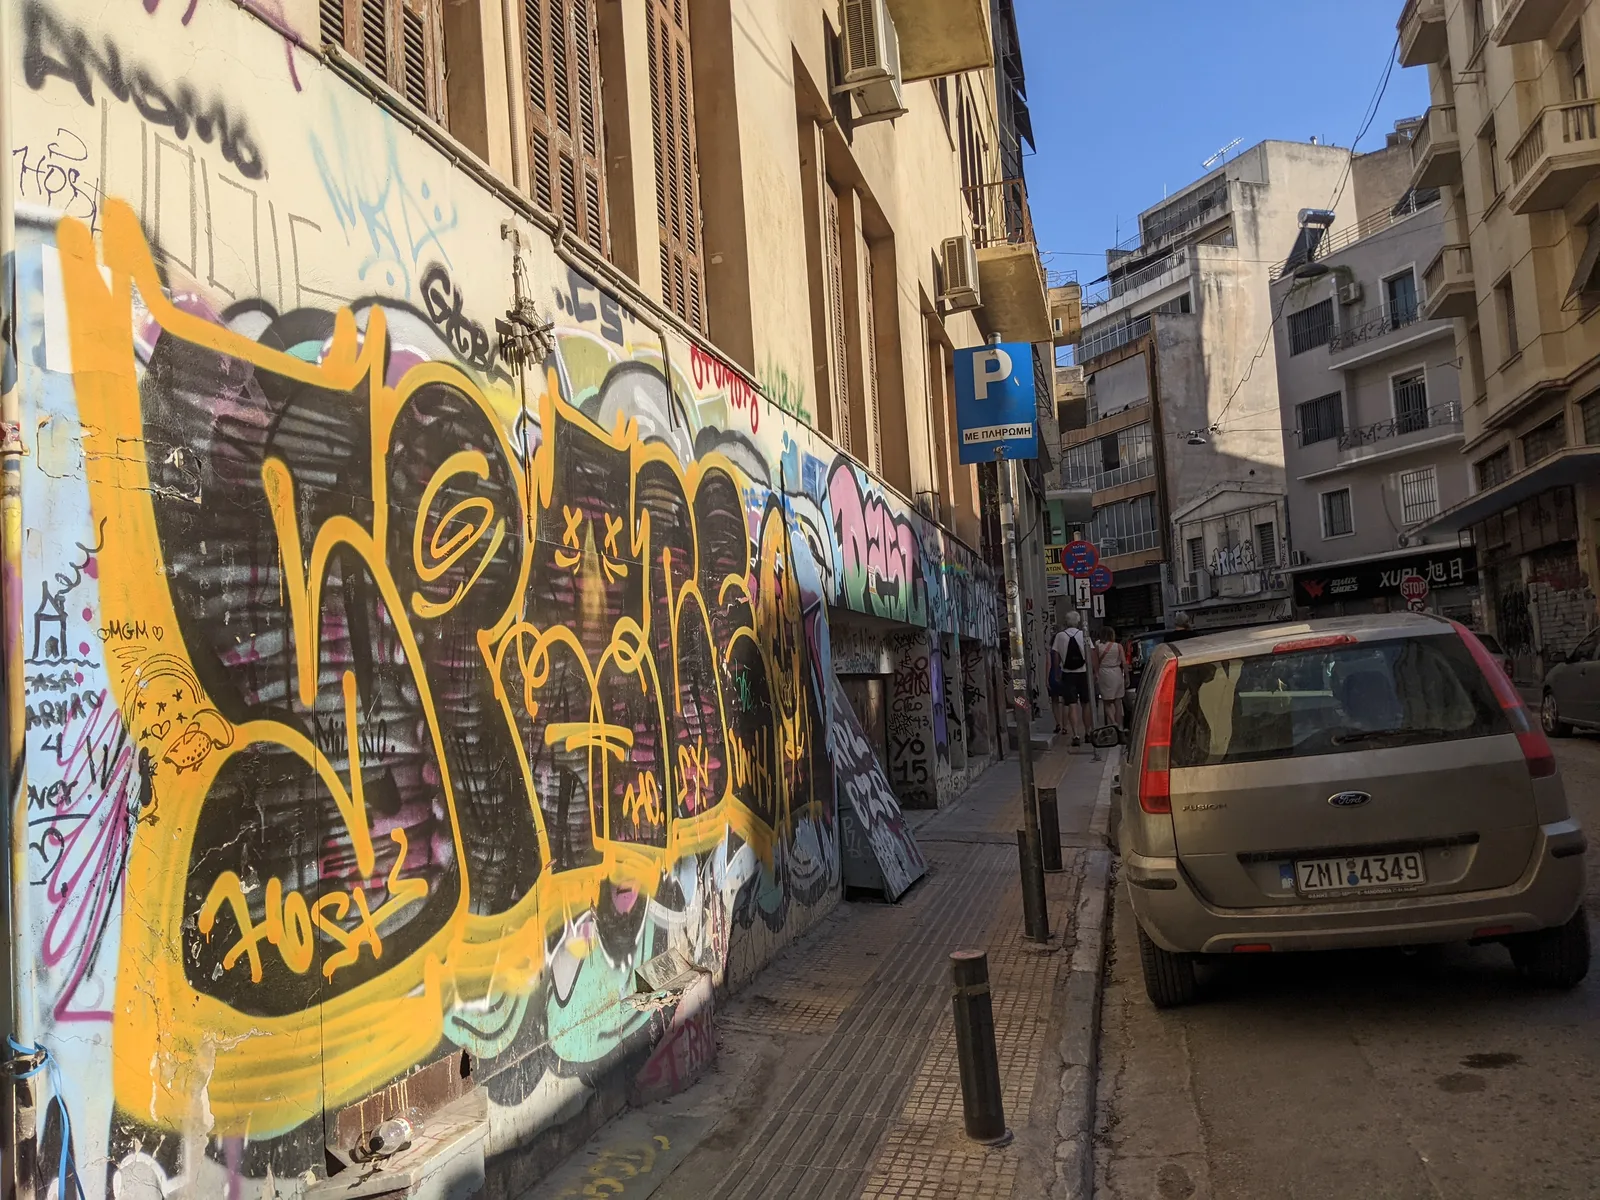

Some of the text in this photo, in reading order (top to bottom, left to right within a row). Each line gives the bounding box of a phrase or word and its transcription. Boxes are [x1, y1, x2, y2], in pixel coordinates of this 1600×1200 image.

[973, 349, 1013, 400] P
[964, 427, 1031, 441] ΜΕ ΠΛΗΡΩΜΗ
[1403, 582, 1426, 595] STOP
[1338, 794, 1363, 805] Ford
